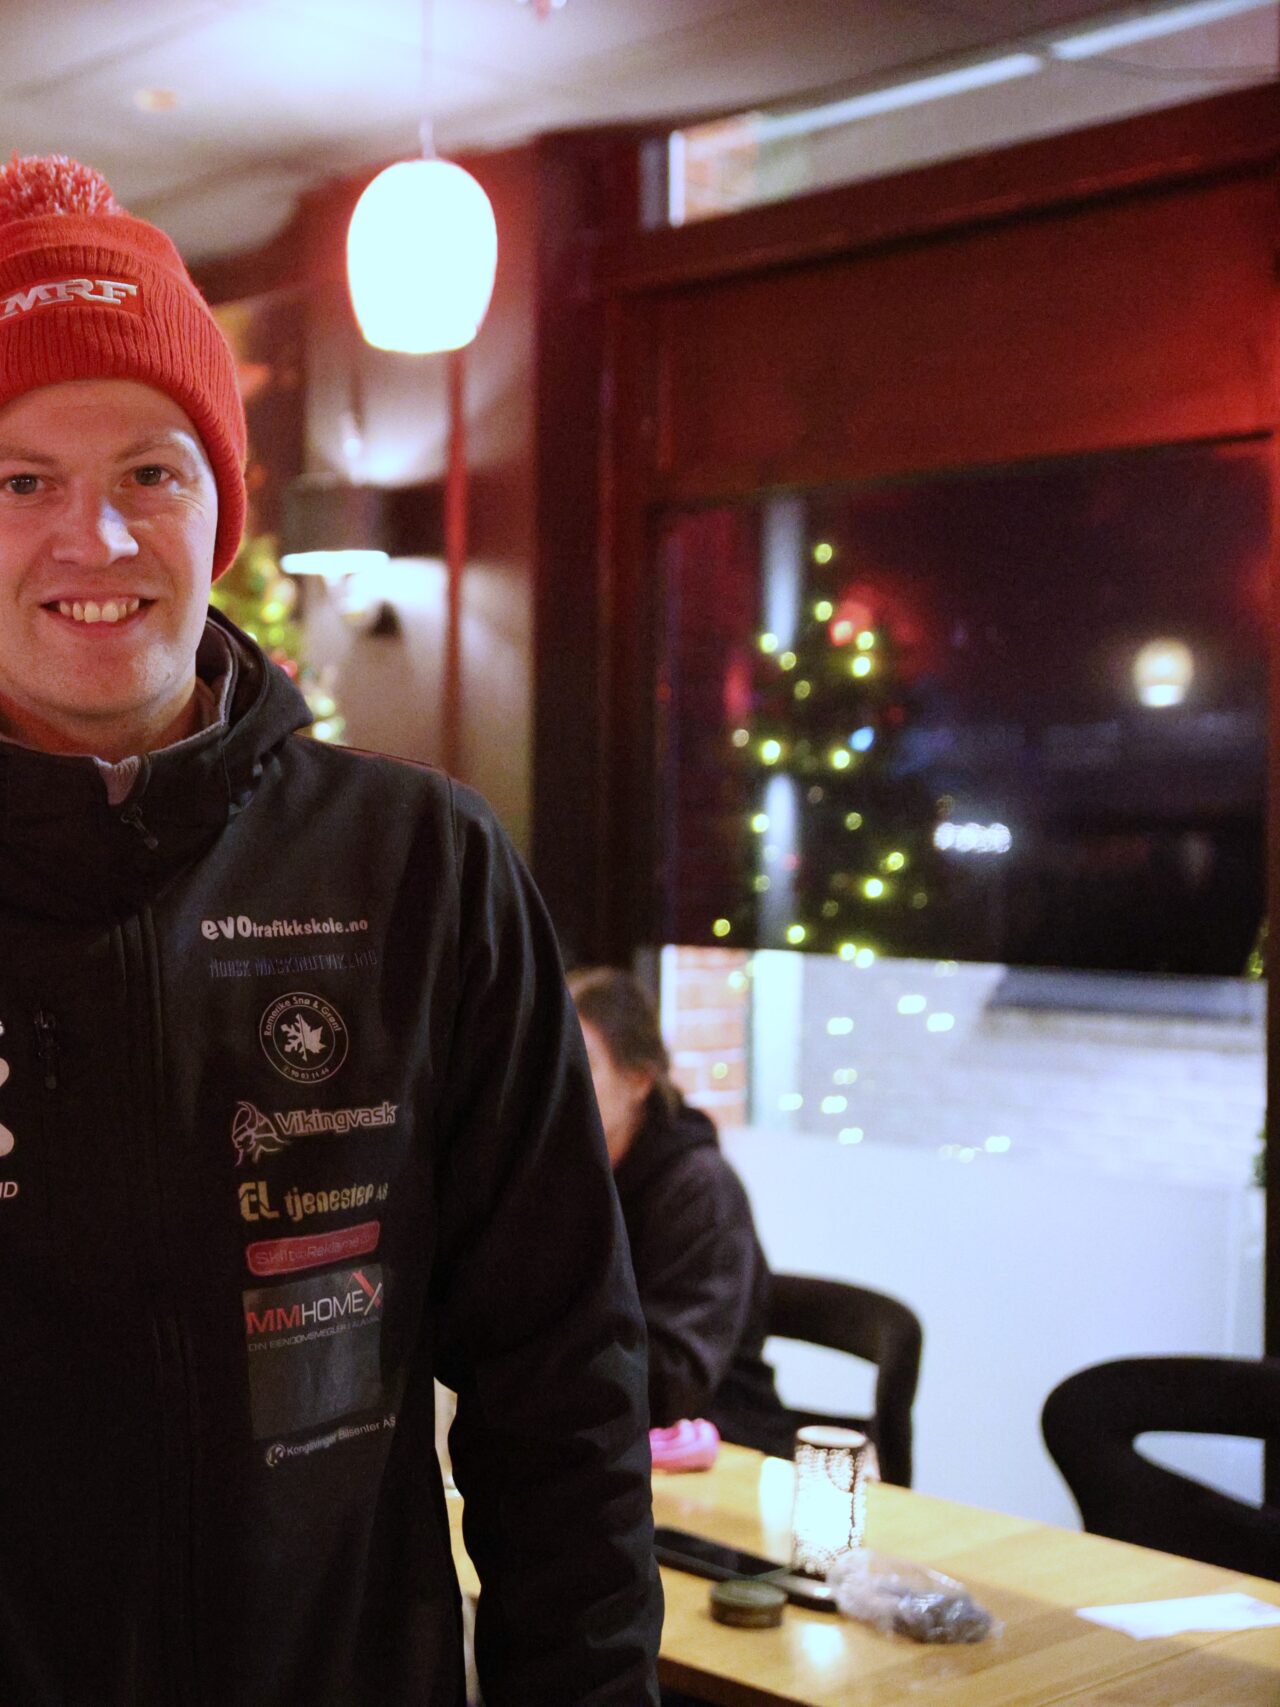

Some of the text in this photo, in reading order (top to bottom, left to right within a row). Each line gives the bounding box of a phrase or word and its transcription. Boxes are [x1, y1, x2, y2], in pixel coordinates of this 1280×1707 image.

[274, 1101, 399, 1136] Vikingvask
[238, 1181, 280, 1221] EL
[284, 1182, 375, 1222] tjenester
[382, 1413, 397, 1429] AS
